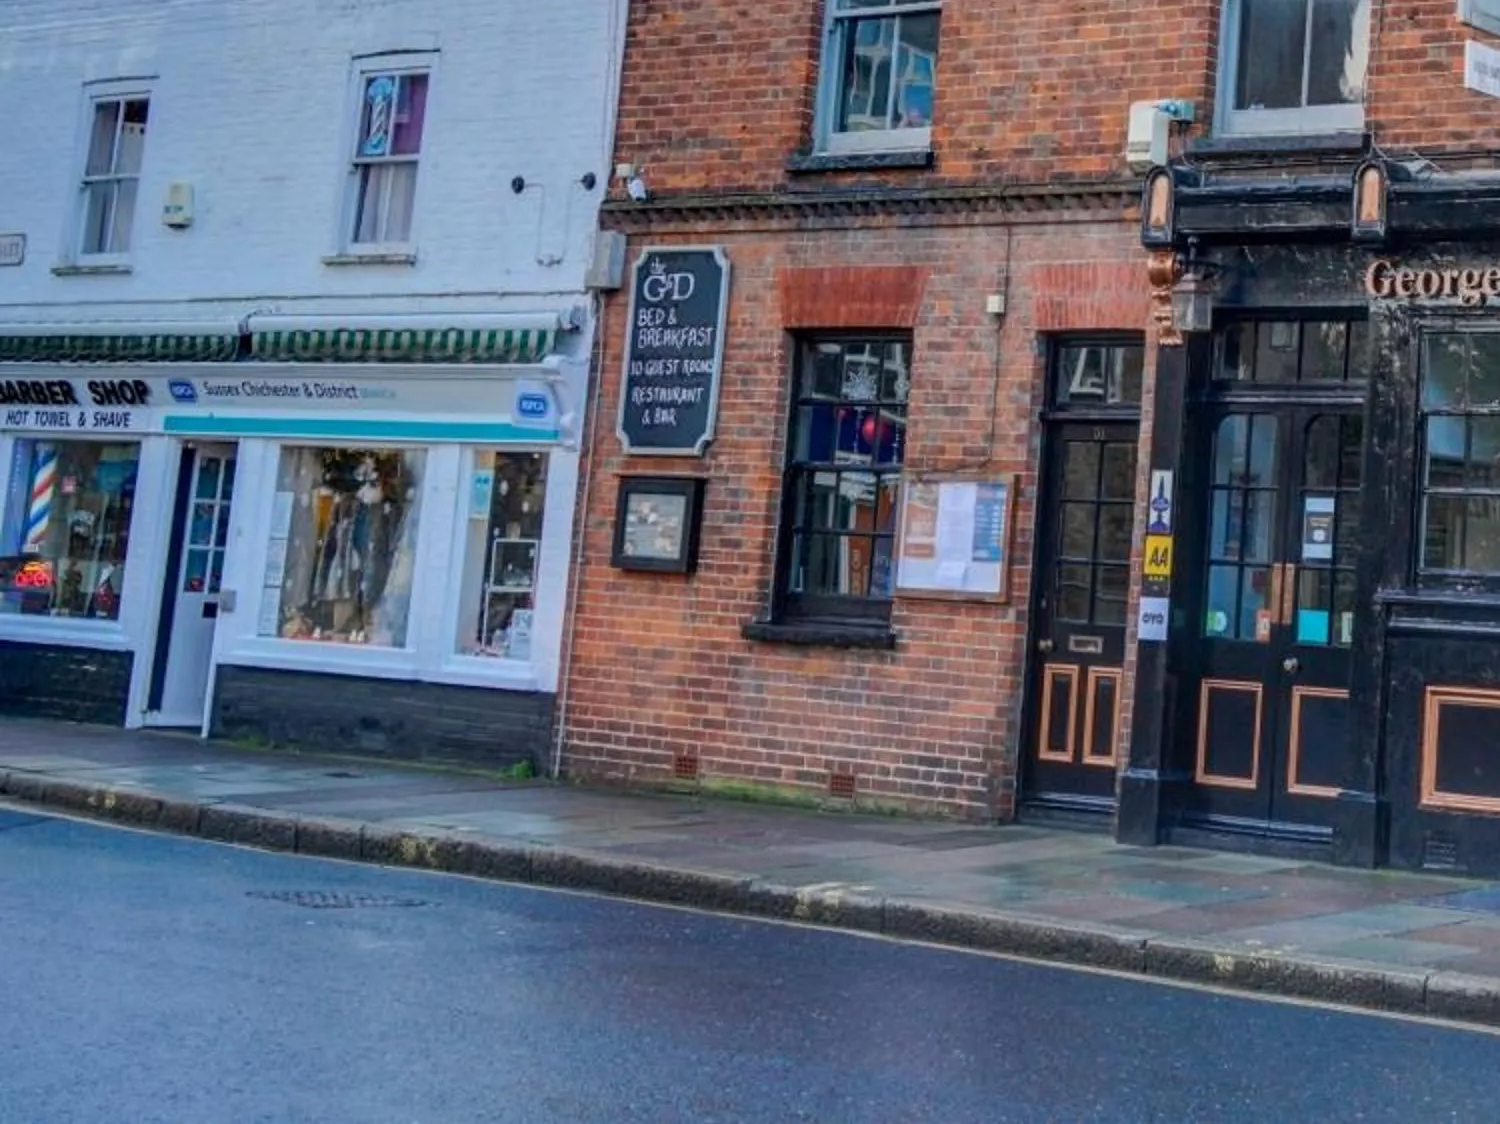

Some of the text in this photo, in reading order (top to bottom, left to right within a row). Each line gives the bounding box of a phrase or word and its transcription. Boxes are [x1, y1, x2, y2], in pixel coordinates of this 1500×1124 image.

[638, 307, 677, 327] BED &
[638, 327, 714, 350] BREAKFAST
[645, 359, 681, 375] GUEST
[682, 359, 714, 376] ROOMS
[87, 379, 150, 405] SHOP
[203, 380, 240, 396] Sussex
[241, 381, 300, 398] Chichester
[302, 382, 313, 394] &
[313, 383, 359, 400] District
[632, 387, 704, 406] RESTAURANT
[5, 410, 131, 428] HOT TOWEL & SHAVE
[653, 407, 677, 427] BAR
[1150, 547, 1168, 568] AA
